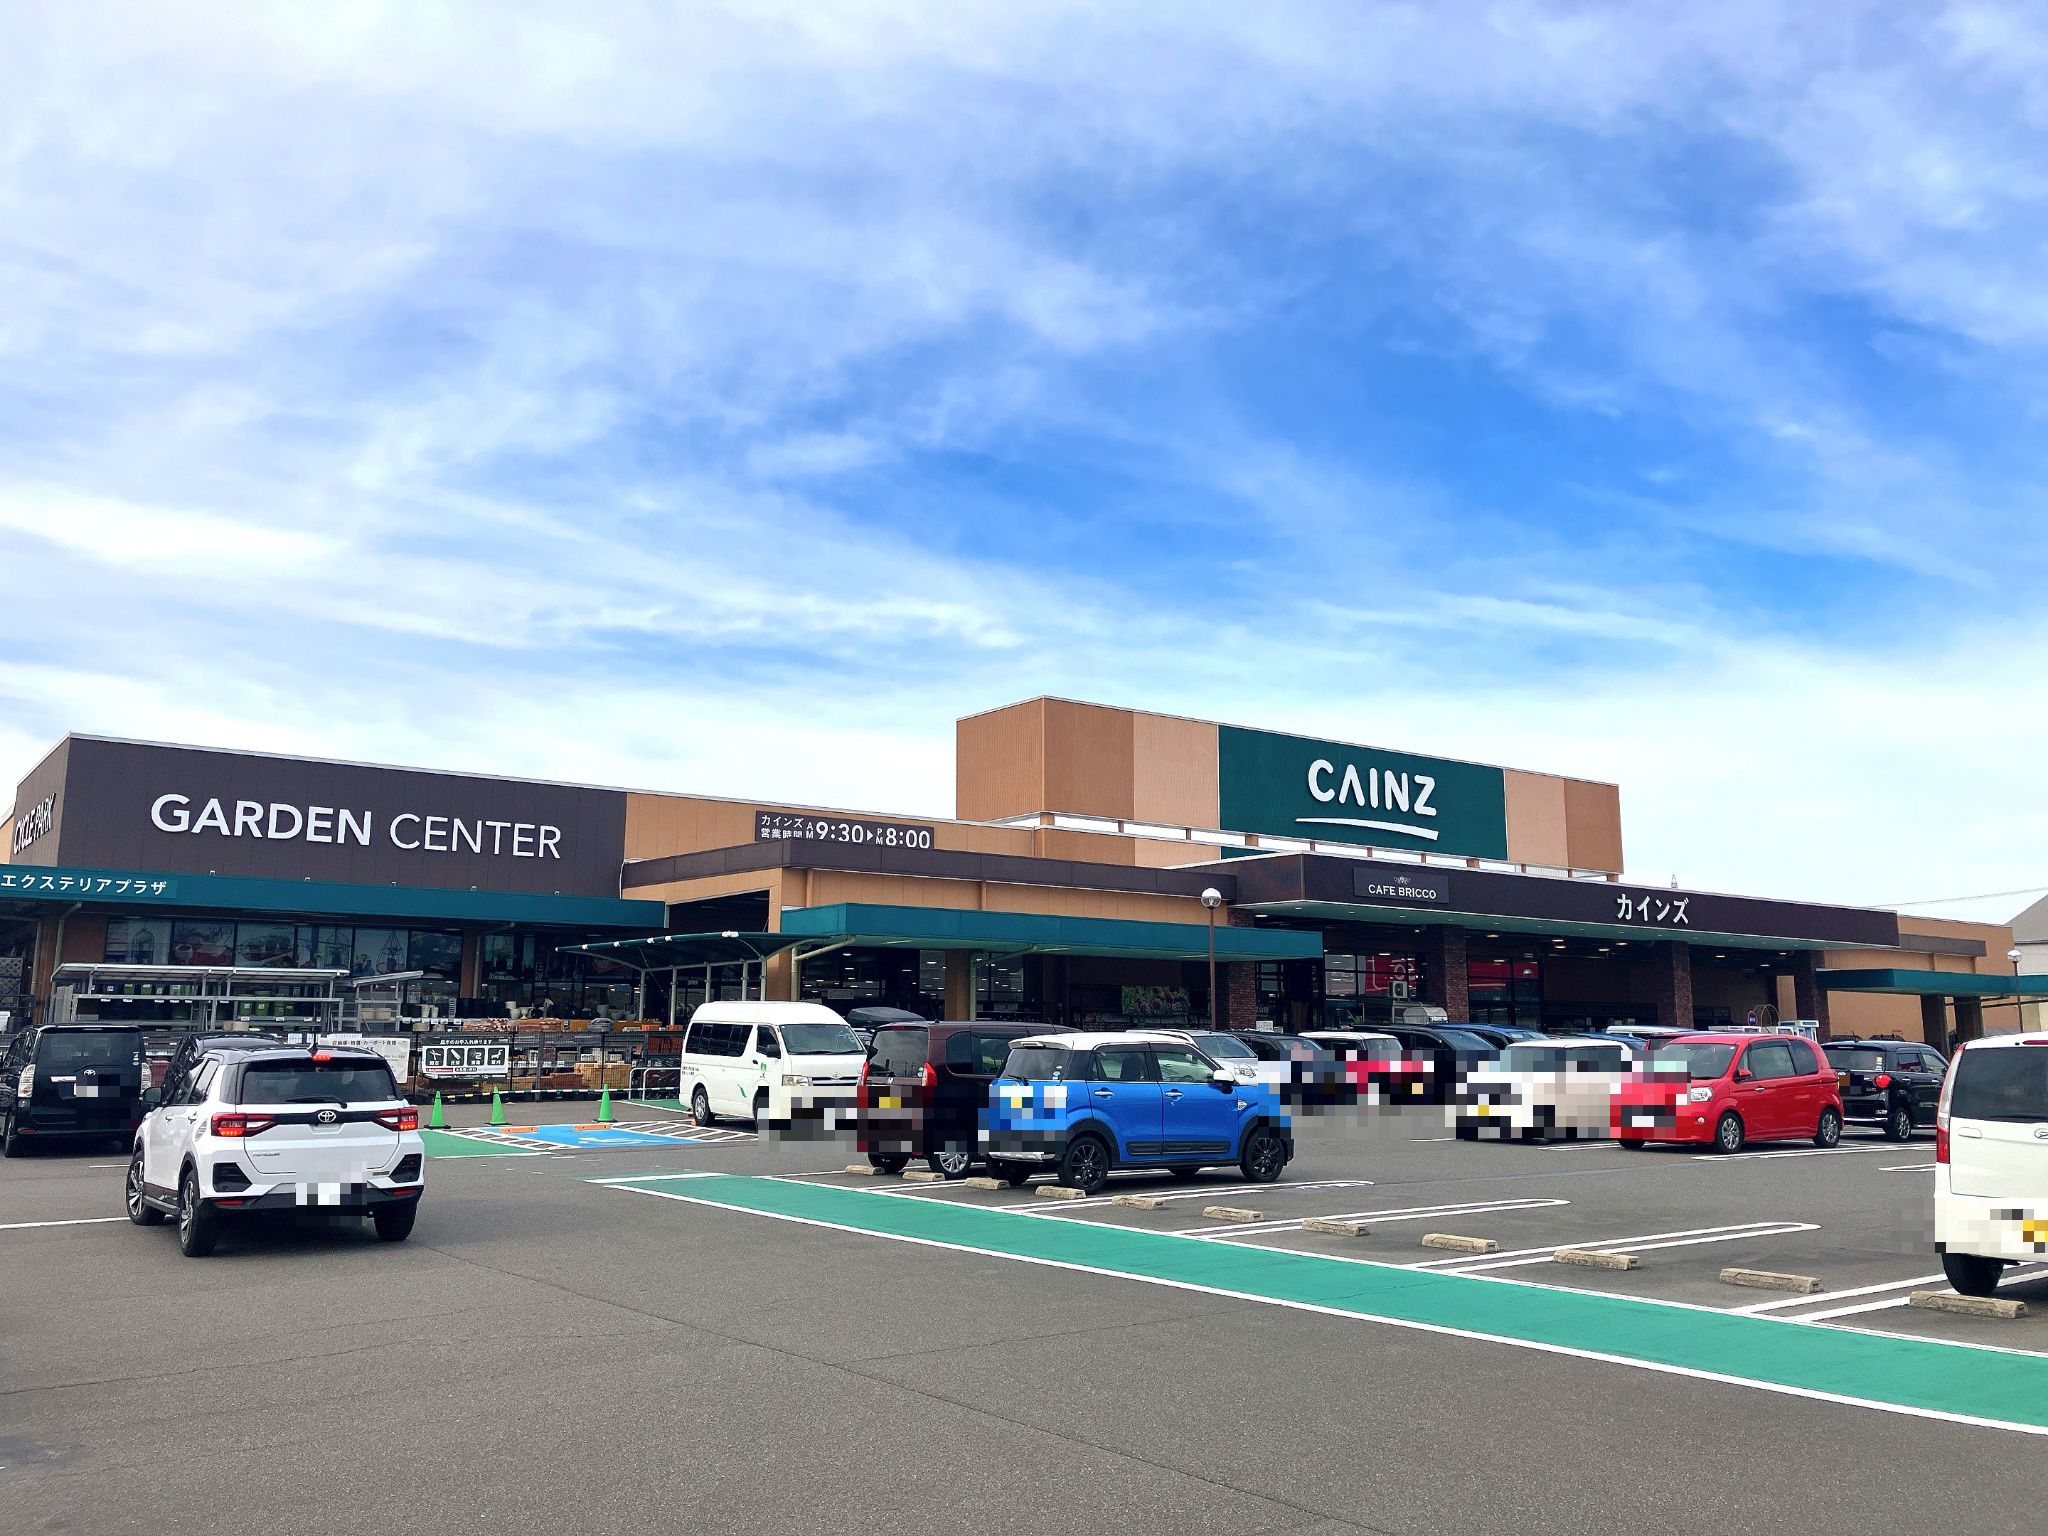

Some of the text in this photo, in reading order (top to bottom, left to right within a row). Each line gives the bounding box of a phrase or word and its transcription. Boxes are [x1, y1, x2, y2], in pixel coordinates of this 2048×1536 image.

[1308, 759, 1437, 816] CAINZ
[150, 793, 561, 859] GARDEN CENTER
[761, 814, 804, 829] カインズ
[816, 821, 864, 843] 9:30
[885, 827, 931, 849] 8:00
[1, 874, 167, 896] エクステリアプラザ
[1368, 884, 1437, 899] CAFE BRICCO
[1616, 893, 1689, 925] カインズ
